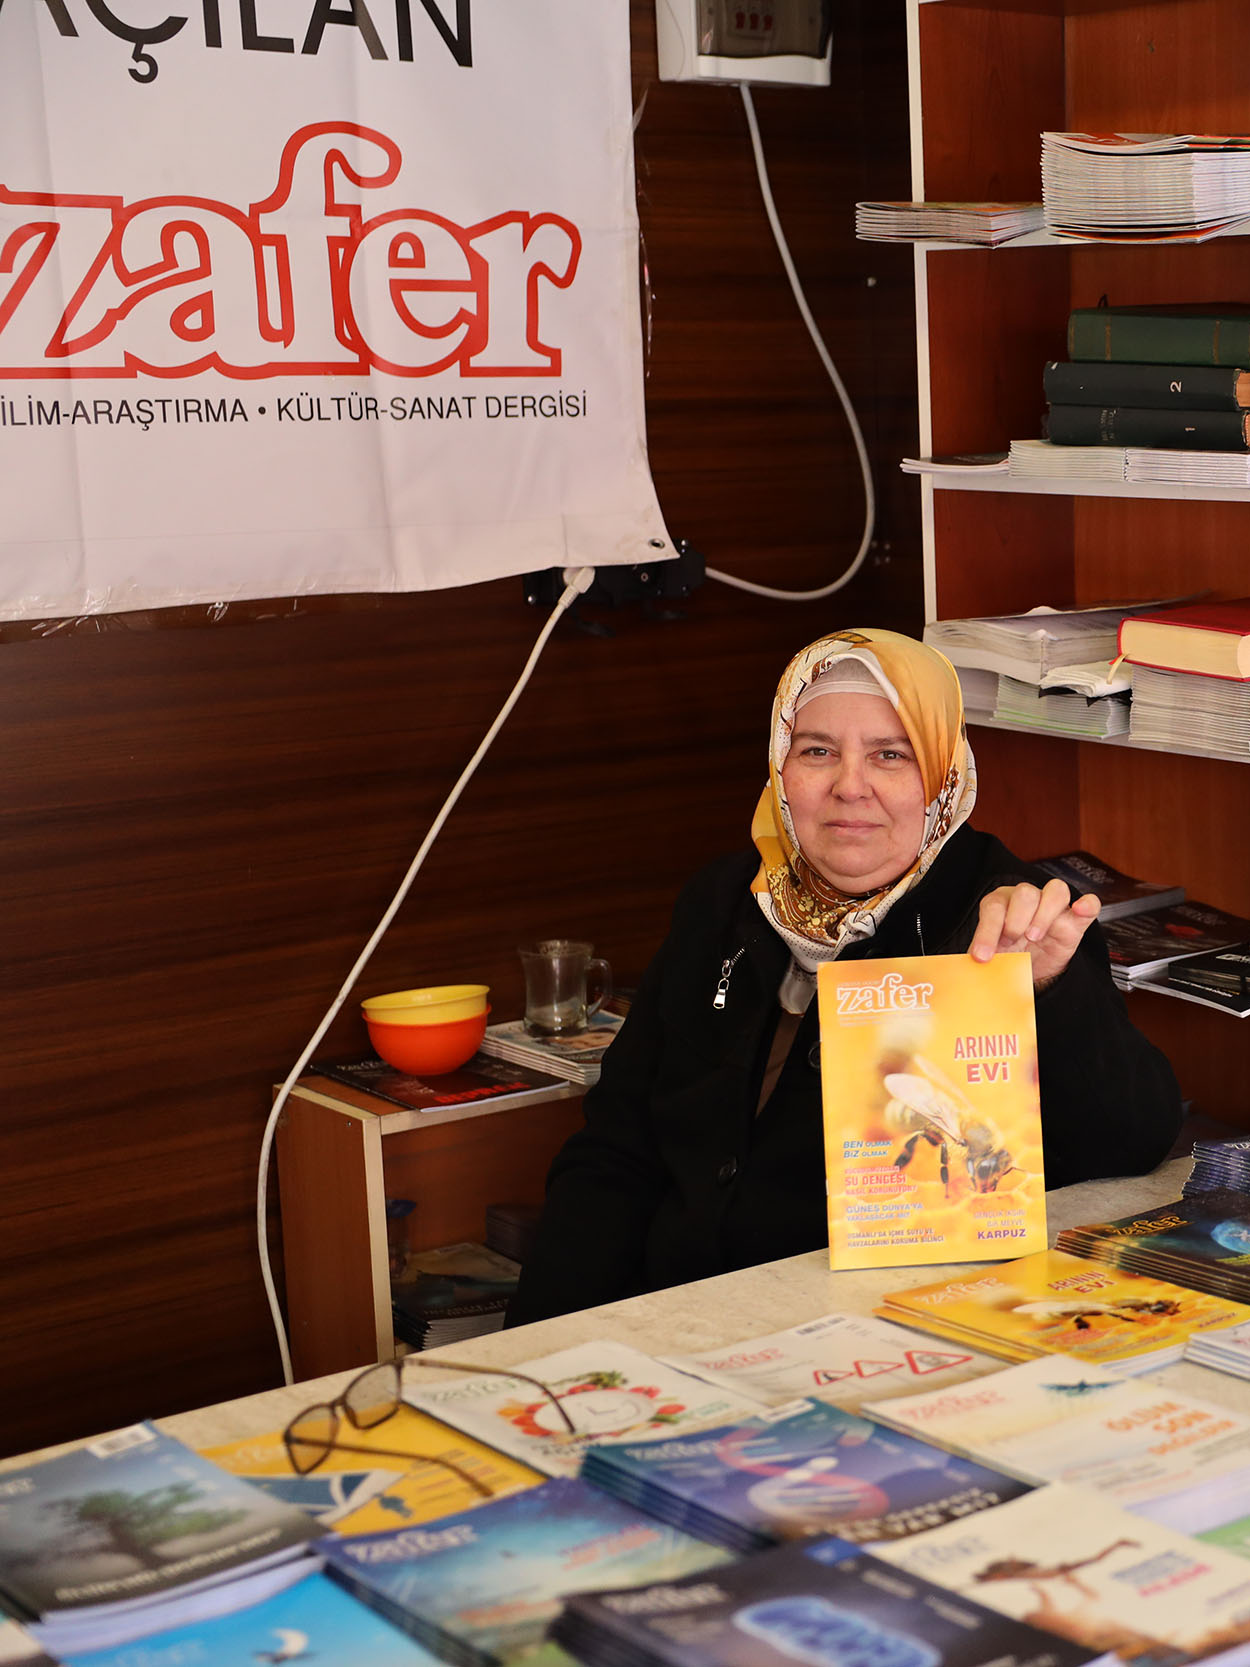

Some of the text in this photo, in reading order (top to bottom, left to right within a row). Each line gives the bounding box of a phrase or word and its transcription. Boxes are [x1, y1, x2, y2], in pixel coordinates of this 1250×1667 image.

[0, 121, 582, 379] zafer
[1170, 381, 1182, 393] 2
[277, 391, 475, 422] KÜLTÜR-SANAT
[485, 389, 588, 419] DERGİSİ
[836, 973, 934, 1015] zafer
[953, 1033, 1019, 1060] ARININ
[977, 1228, 1027, 1240] KARPUZ
